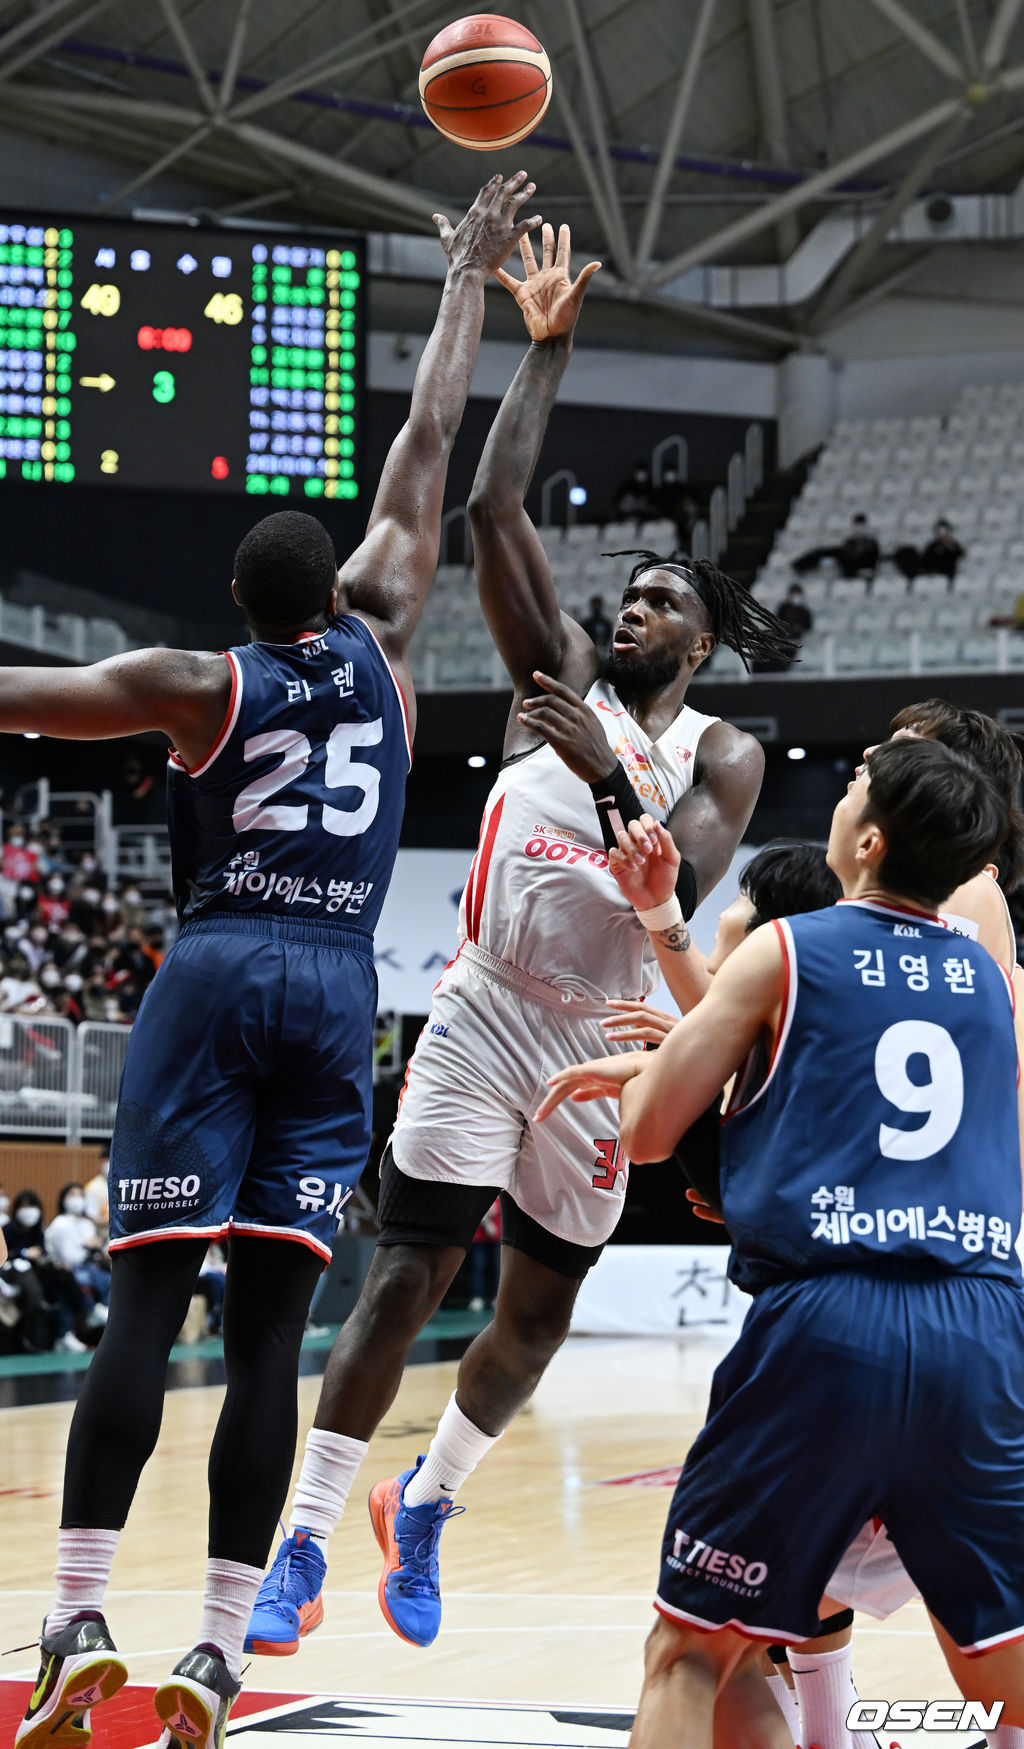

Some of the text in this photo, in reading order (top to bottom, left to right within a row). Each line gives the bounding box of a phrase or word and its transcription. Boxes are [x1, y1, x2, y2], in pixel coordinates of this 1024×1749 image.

[204, 292, 243, 325] 46
[153, 371, 175, 402] 3
[302, 639, 329, 660] KBL
[232, 717, 383, 836] 25
[533, 824, 547, 834] SK
[525, 838, 609, 869] 0070
[893, 923, 923, 938] KBL
[874, 1020, 964, 1161] 9
[147, 1199, 200, 1210] YOURSELF
[811, 1186, 855, 1211] 수원
[811, 1206, 1012, 1260] 제이에스병원
[704, 1574, 762, 1598] YOURSELF
